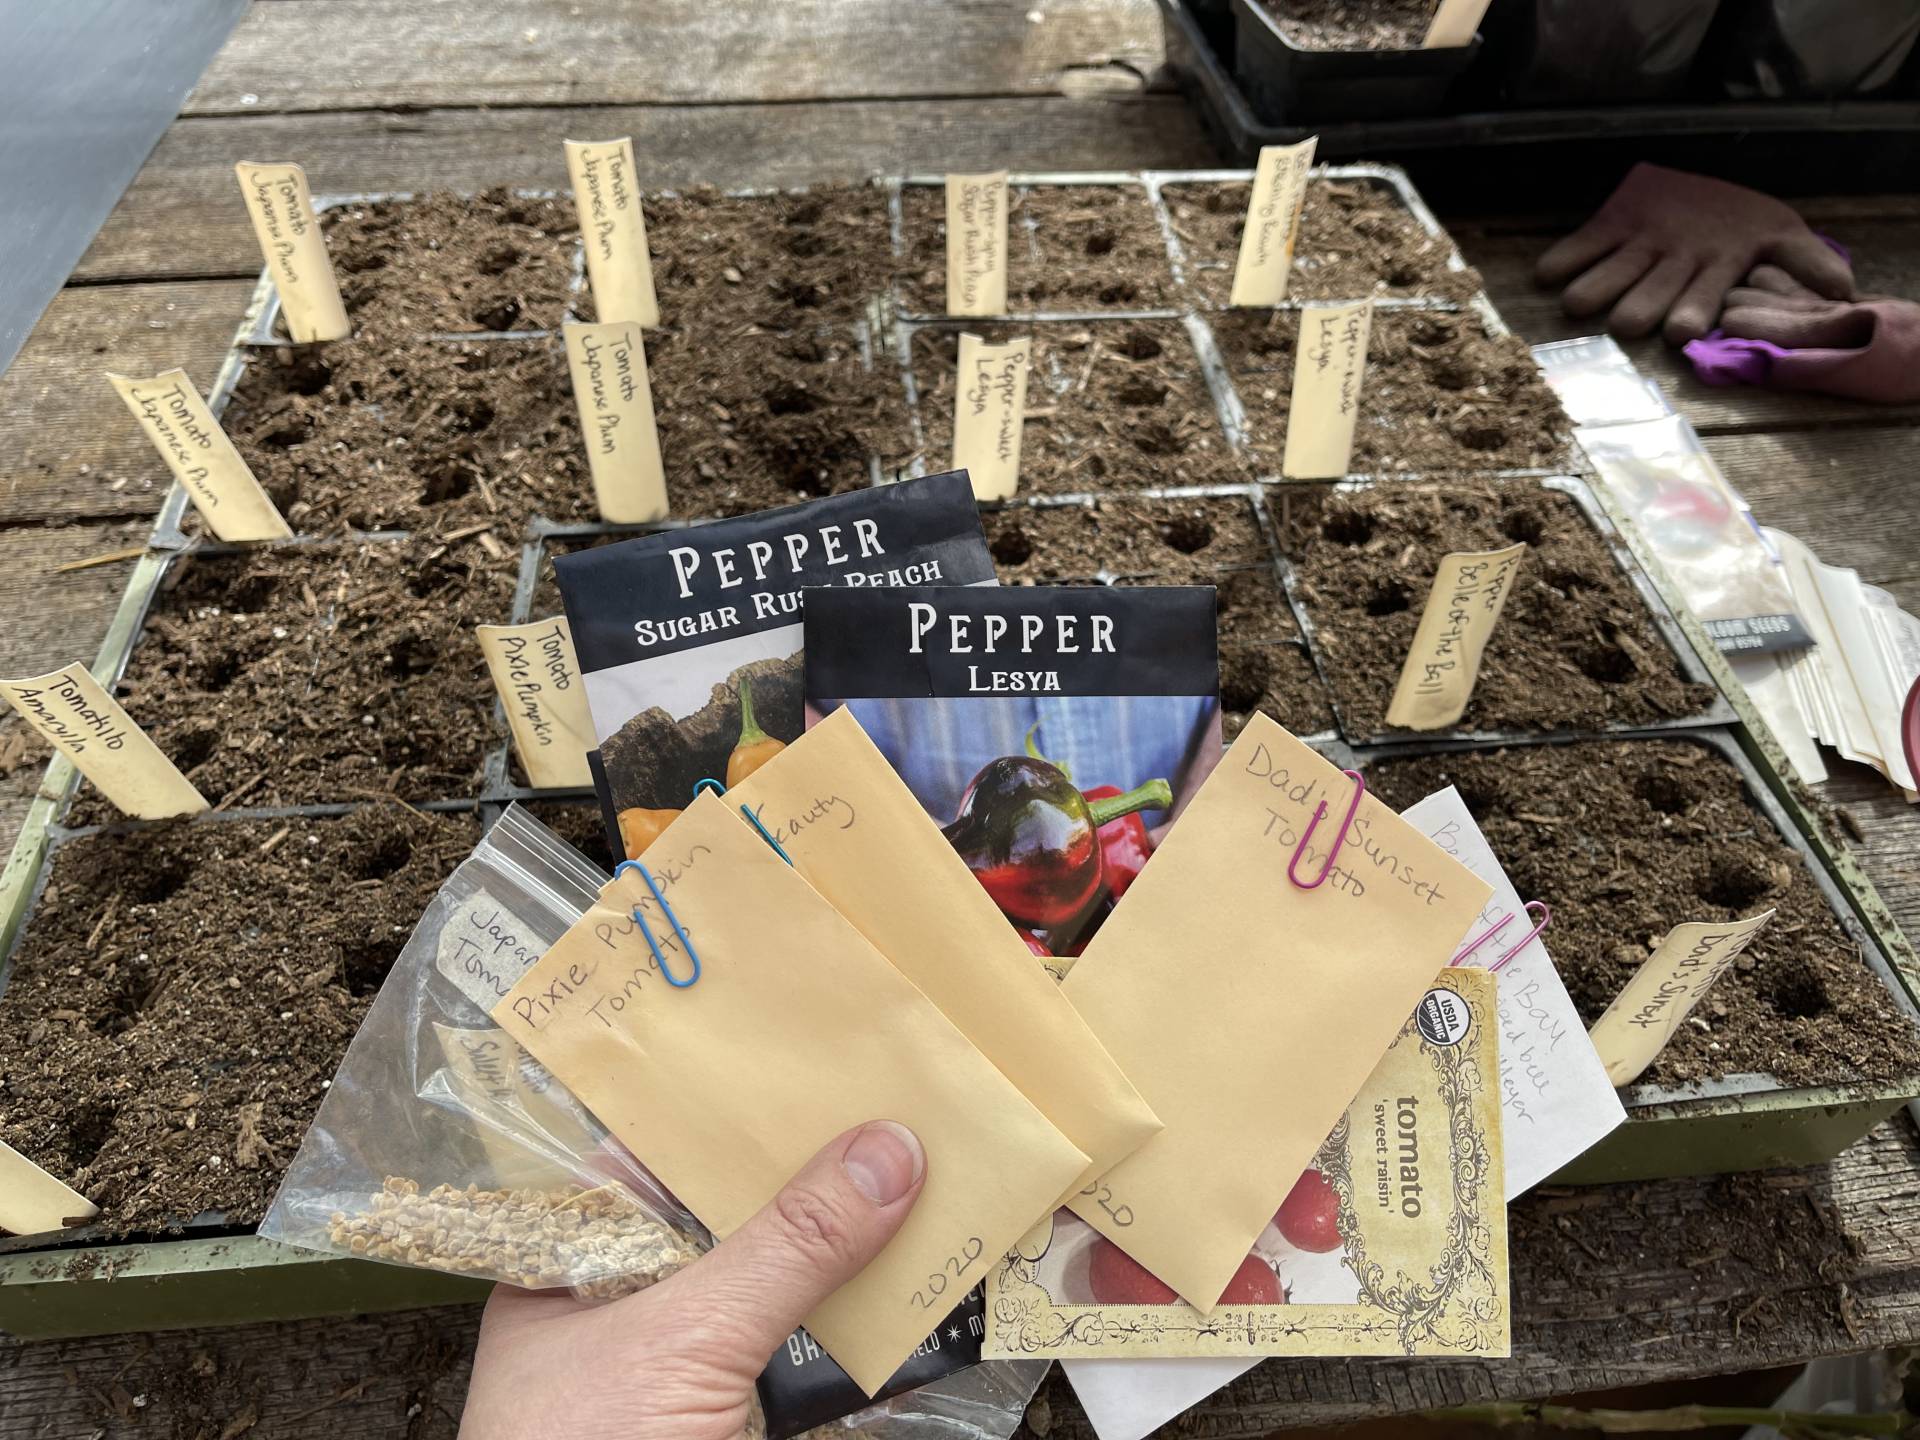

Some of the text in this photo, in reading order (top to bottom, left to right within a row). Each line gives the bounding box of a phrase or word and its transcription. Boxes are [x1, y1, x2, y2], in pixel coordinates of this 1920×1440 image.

[276, 173, 309, 236] Tomato
[607, 145, 630, 211] Tomato
[594, 220, 616, 261] Plum
[609, 332, 639, 402] Tomato
[161, 382, 213, 449] Tomato
[597, 413, 621, 455] Plum
[668, 518, 886, 599] PEPPER
[1482, 554, 1520, 613] Pepper
[633, 606, 742, 647] SUGAR
[908, 602, 1117, 654] PEPPER
[536, 625, 574, 691] Tomato
[967, 665, 1062, 692] LESYA
[1414, 660, 1456, 695] Ball
[498, 636, 553, 747] Pixie Pumpkin
[757, 795, 856, 845] eauty
[1344, 817, 1447, 906] Sunset
[454, 936, 512, 997] Tom
[470, 911, 540, 966] Japan
[1672, 931, 1736, 980] Dad's
[511, 962, 590, 1029] Pixie
[1425, 999, 1446, 1040] ORGANIC
[1440, 998, 1460, 1033] USDA
[1396, 1095, 1424, 1219] tomato
[910, 1235, 984, 1310] 2020
[907, 1330, 942, 1361] IELD
